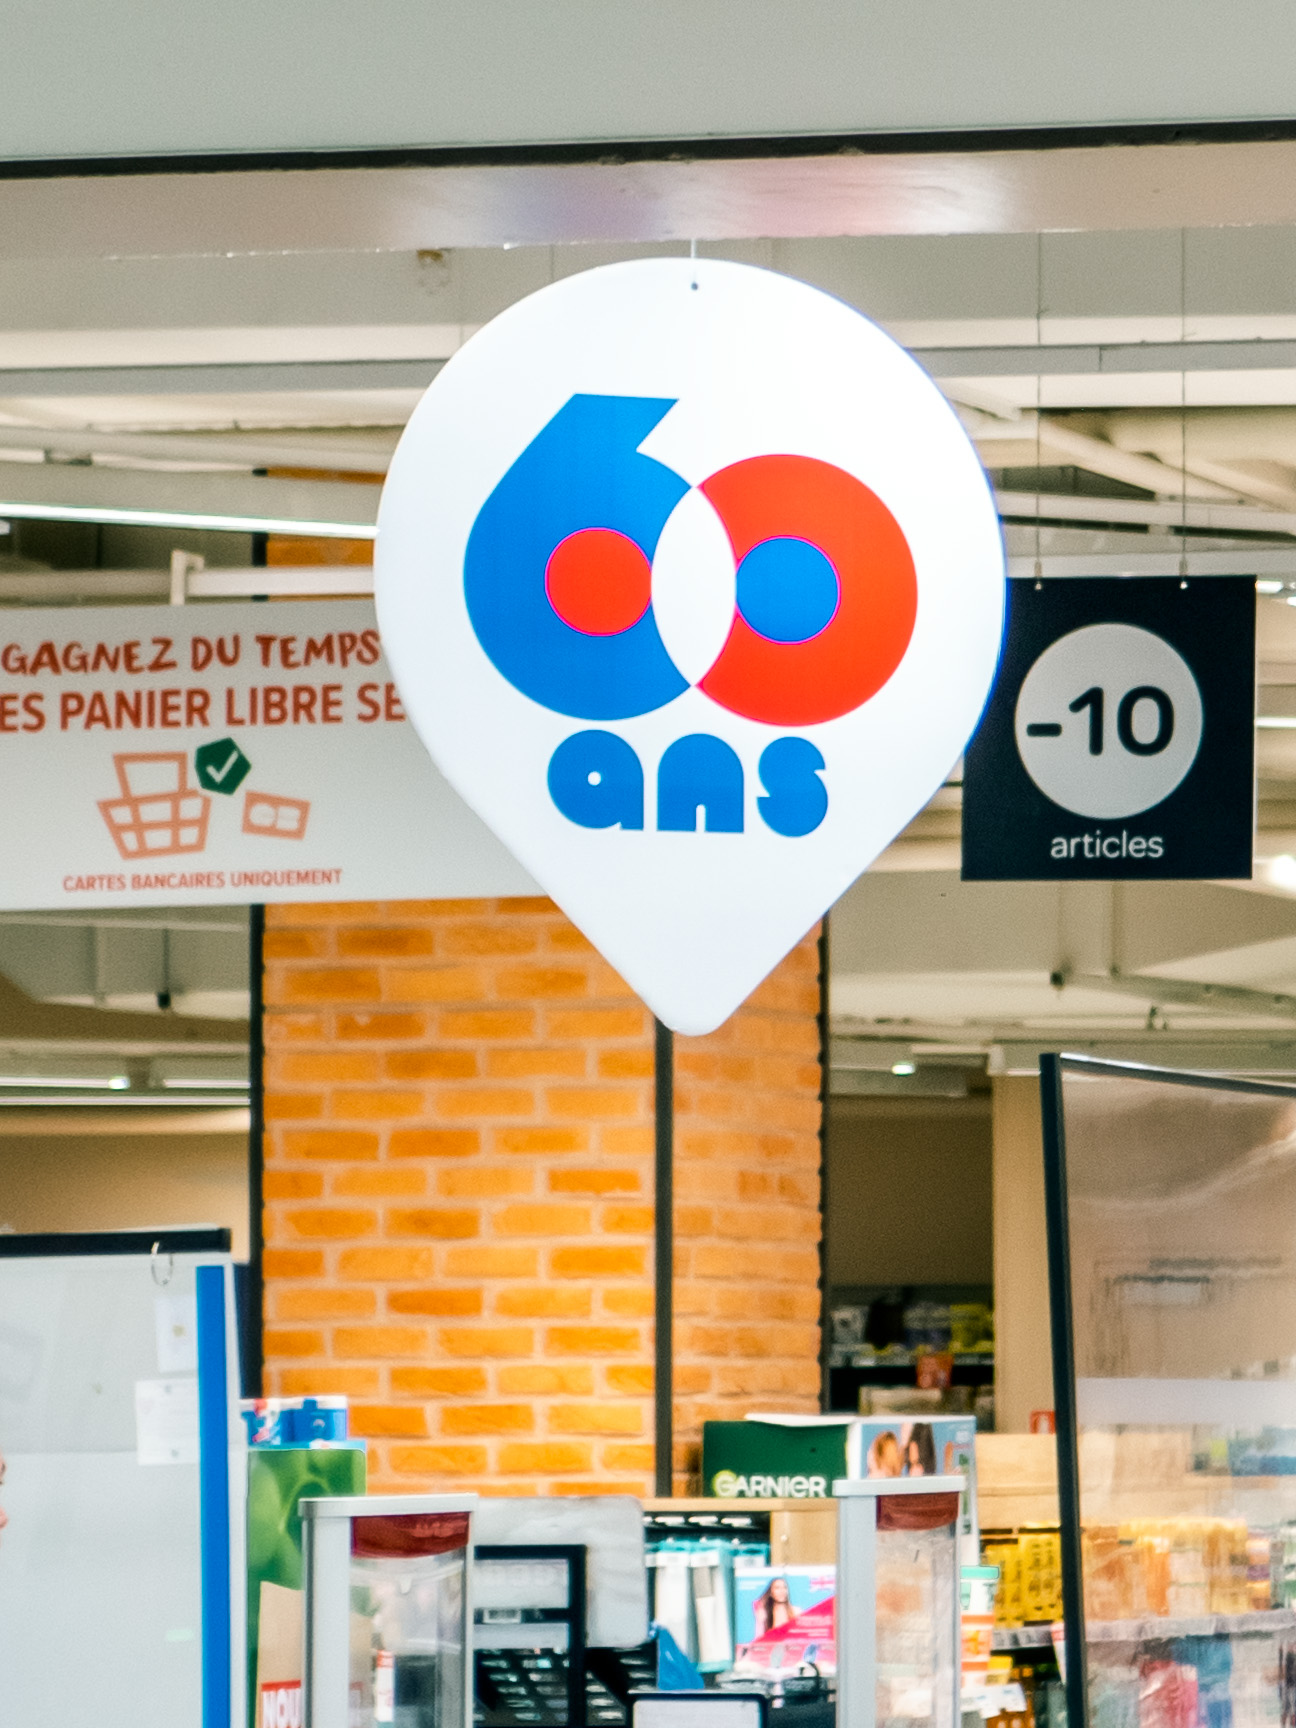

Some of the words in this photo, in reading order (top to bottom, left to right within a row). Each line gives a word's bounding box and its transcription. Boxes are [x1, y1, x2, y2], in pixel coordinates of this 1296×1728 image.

[463, 393, 917, 726] 60
[2, 637, 177, 676] GAGNEZ
[191, 635, 240, 671] DU
[256, 629, 381, 669] TEMPS
[60, 688, 211, 731] PANIER
[226, 683, 342, 726] LIBRE
[1027, 685, 1175, 757] -10
[547, 729, 828, 837] ans
[1050, 829, 1164, 861] articles
[63, 875, 126, 892] CARTES
[131, 872, 225, 890] BANCAIRES
[231, 869, 342, 888] UNIQUEMENT
[714, 1474, 827, 1498] GARNIER
